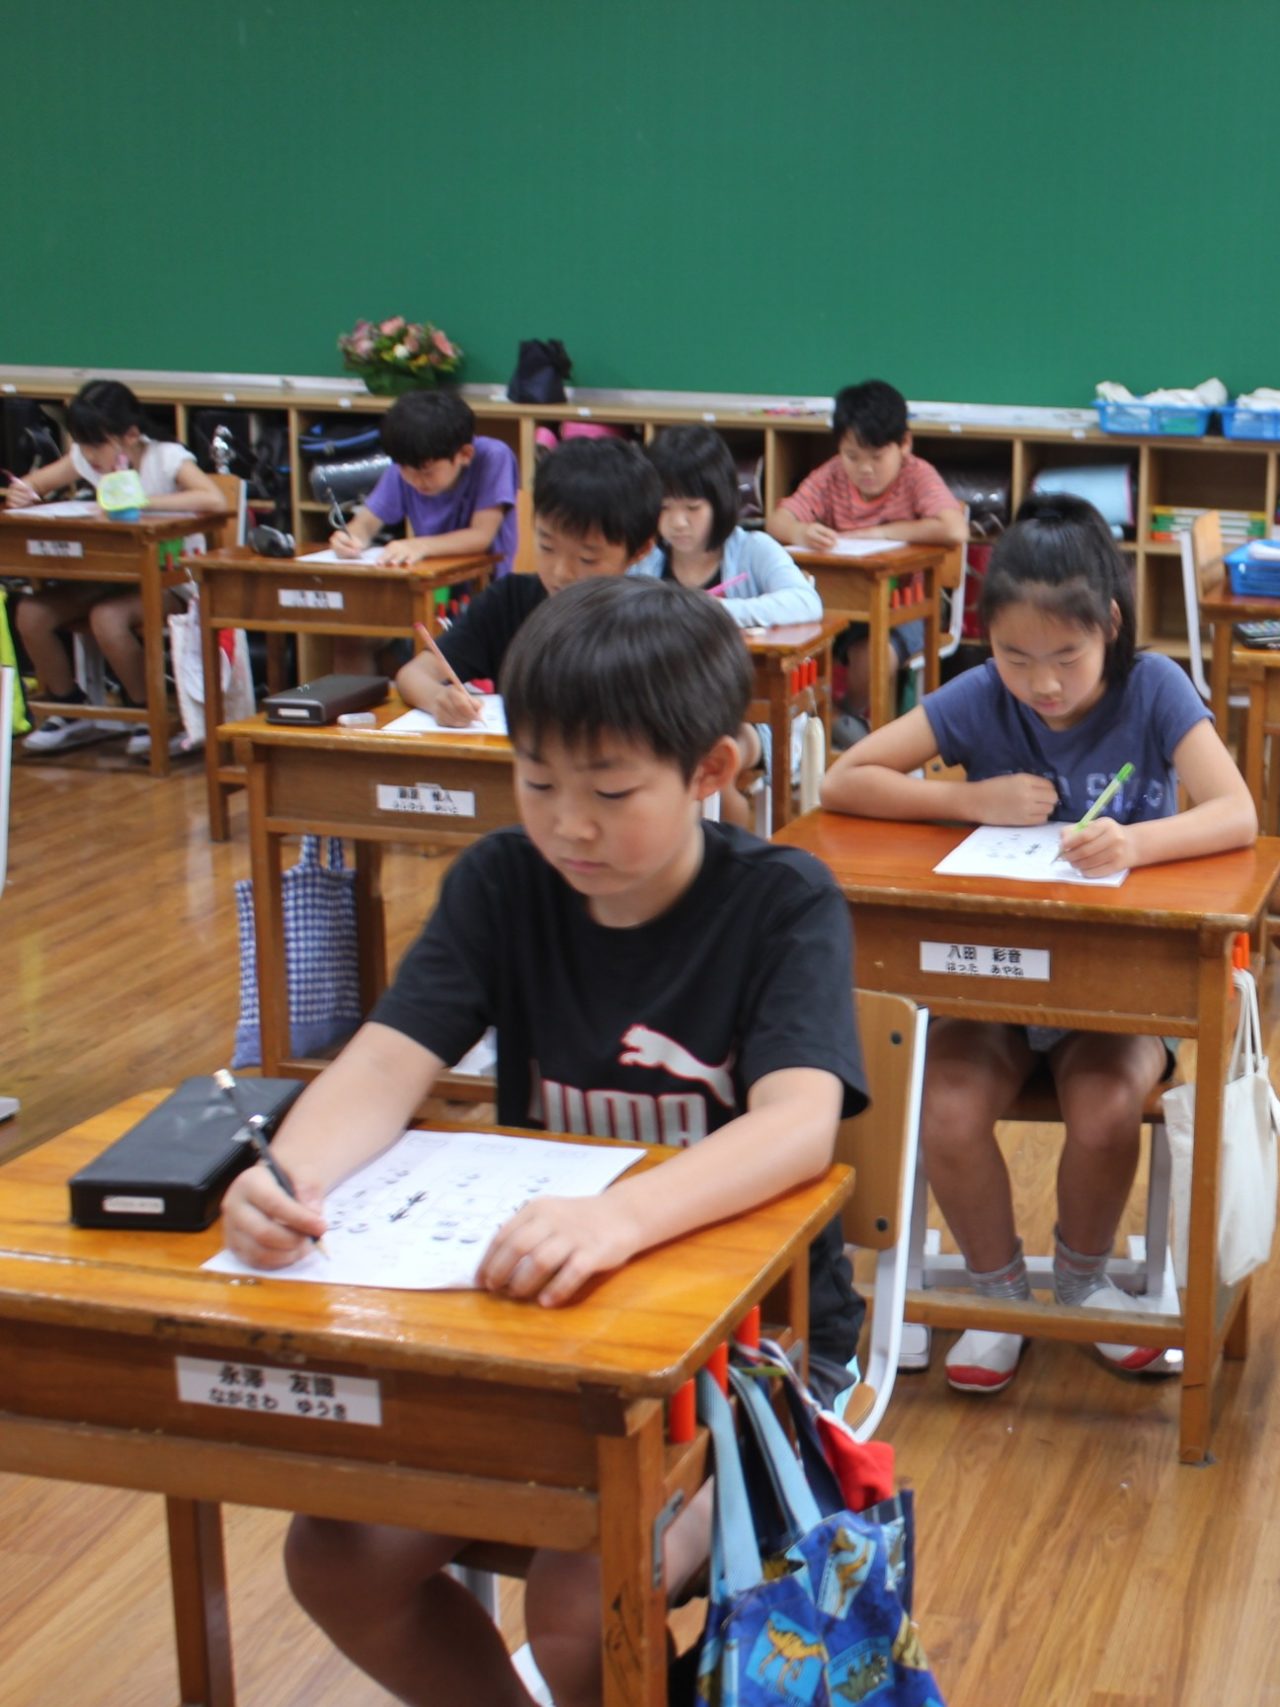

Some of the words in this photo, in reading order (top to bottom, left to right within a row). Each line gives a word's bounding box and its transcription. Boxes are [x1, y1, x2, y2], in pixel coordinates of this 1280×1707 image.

[947, 945, 977, 960] 八田
[945, 962, 979, 974] はった
[991, 964, 1024, 976] あやね
[208, 1388, 278, 1410] ながさわ
